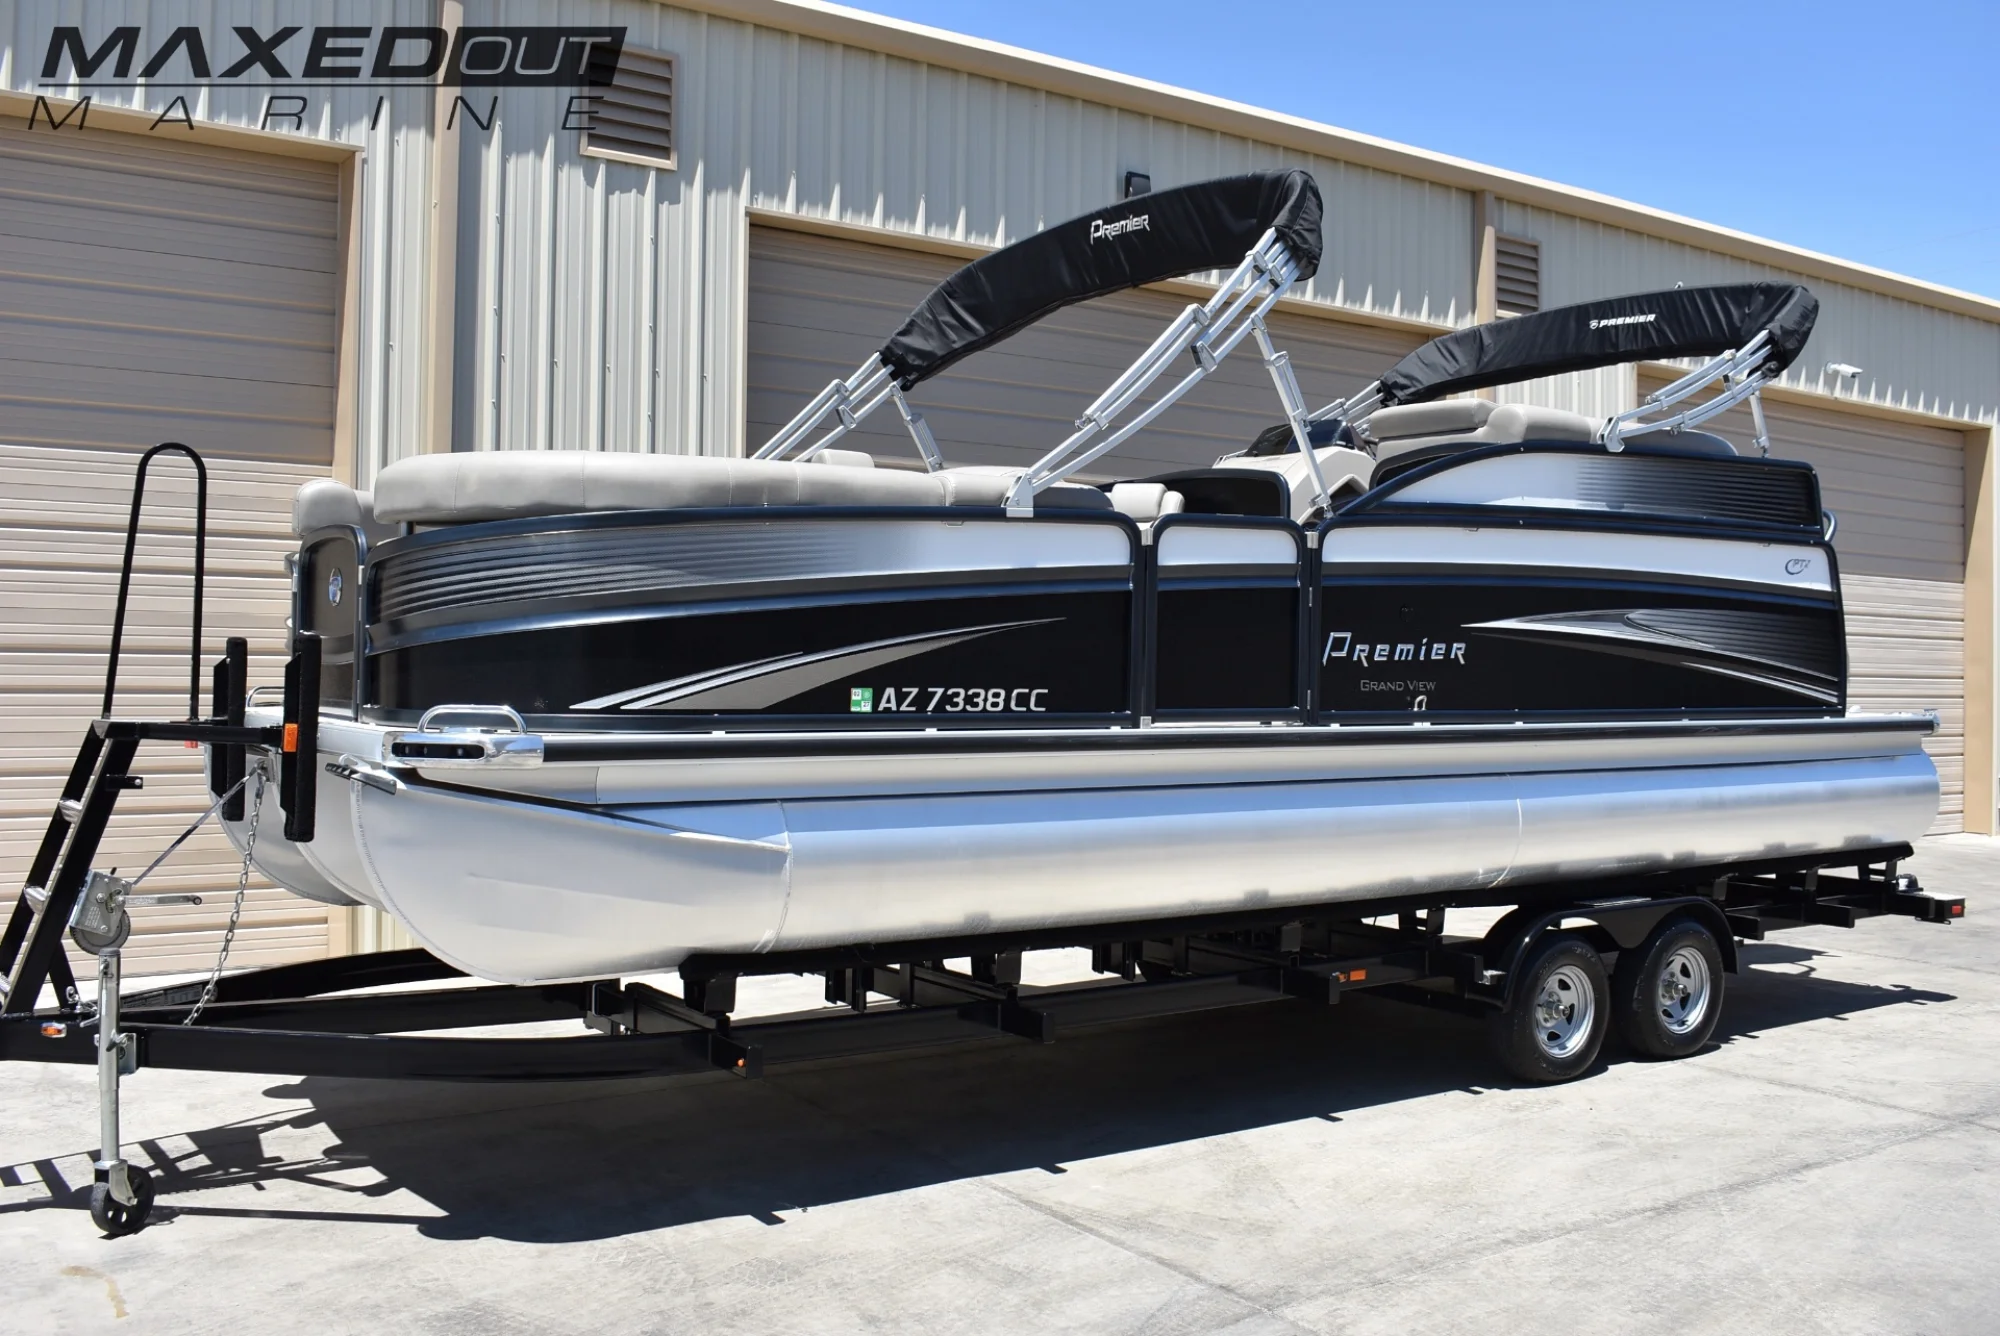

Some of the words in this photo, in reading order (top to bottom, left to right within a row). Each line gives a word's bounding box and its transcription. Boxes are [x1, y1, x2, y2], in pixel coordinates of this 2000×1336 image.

[1090, 214, 1150, 246] Premier
[1599, 314, 1656, 328] PREMIER
[1322, 632, 1466, 667] Premier
[1360, 680, 1404, 691] GRAND
[1407, 680, 1436, 691] VIEW
[877, 687, 919, 712] AZ
